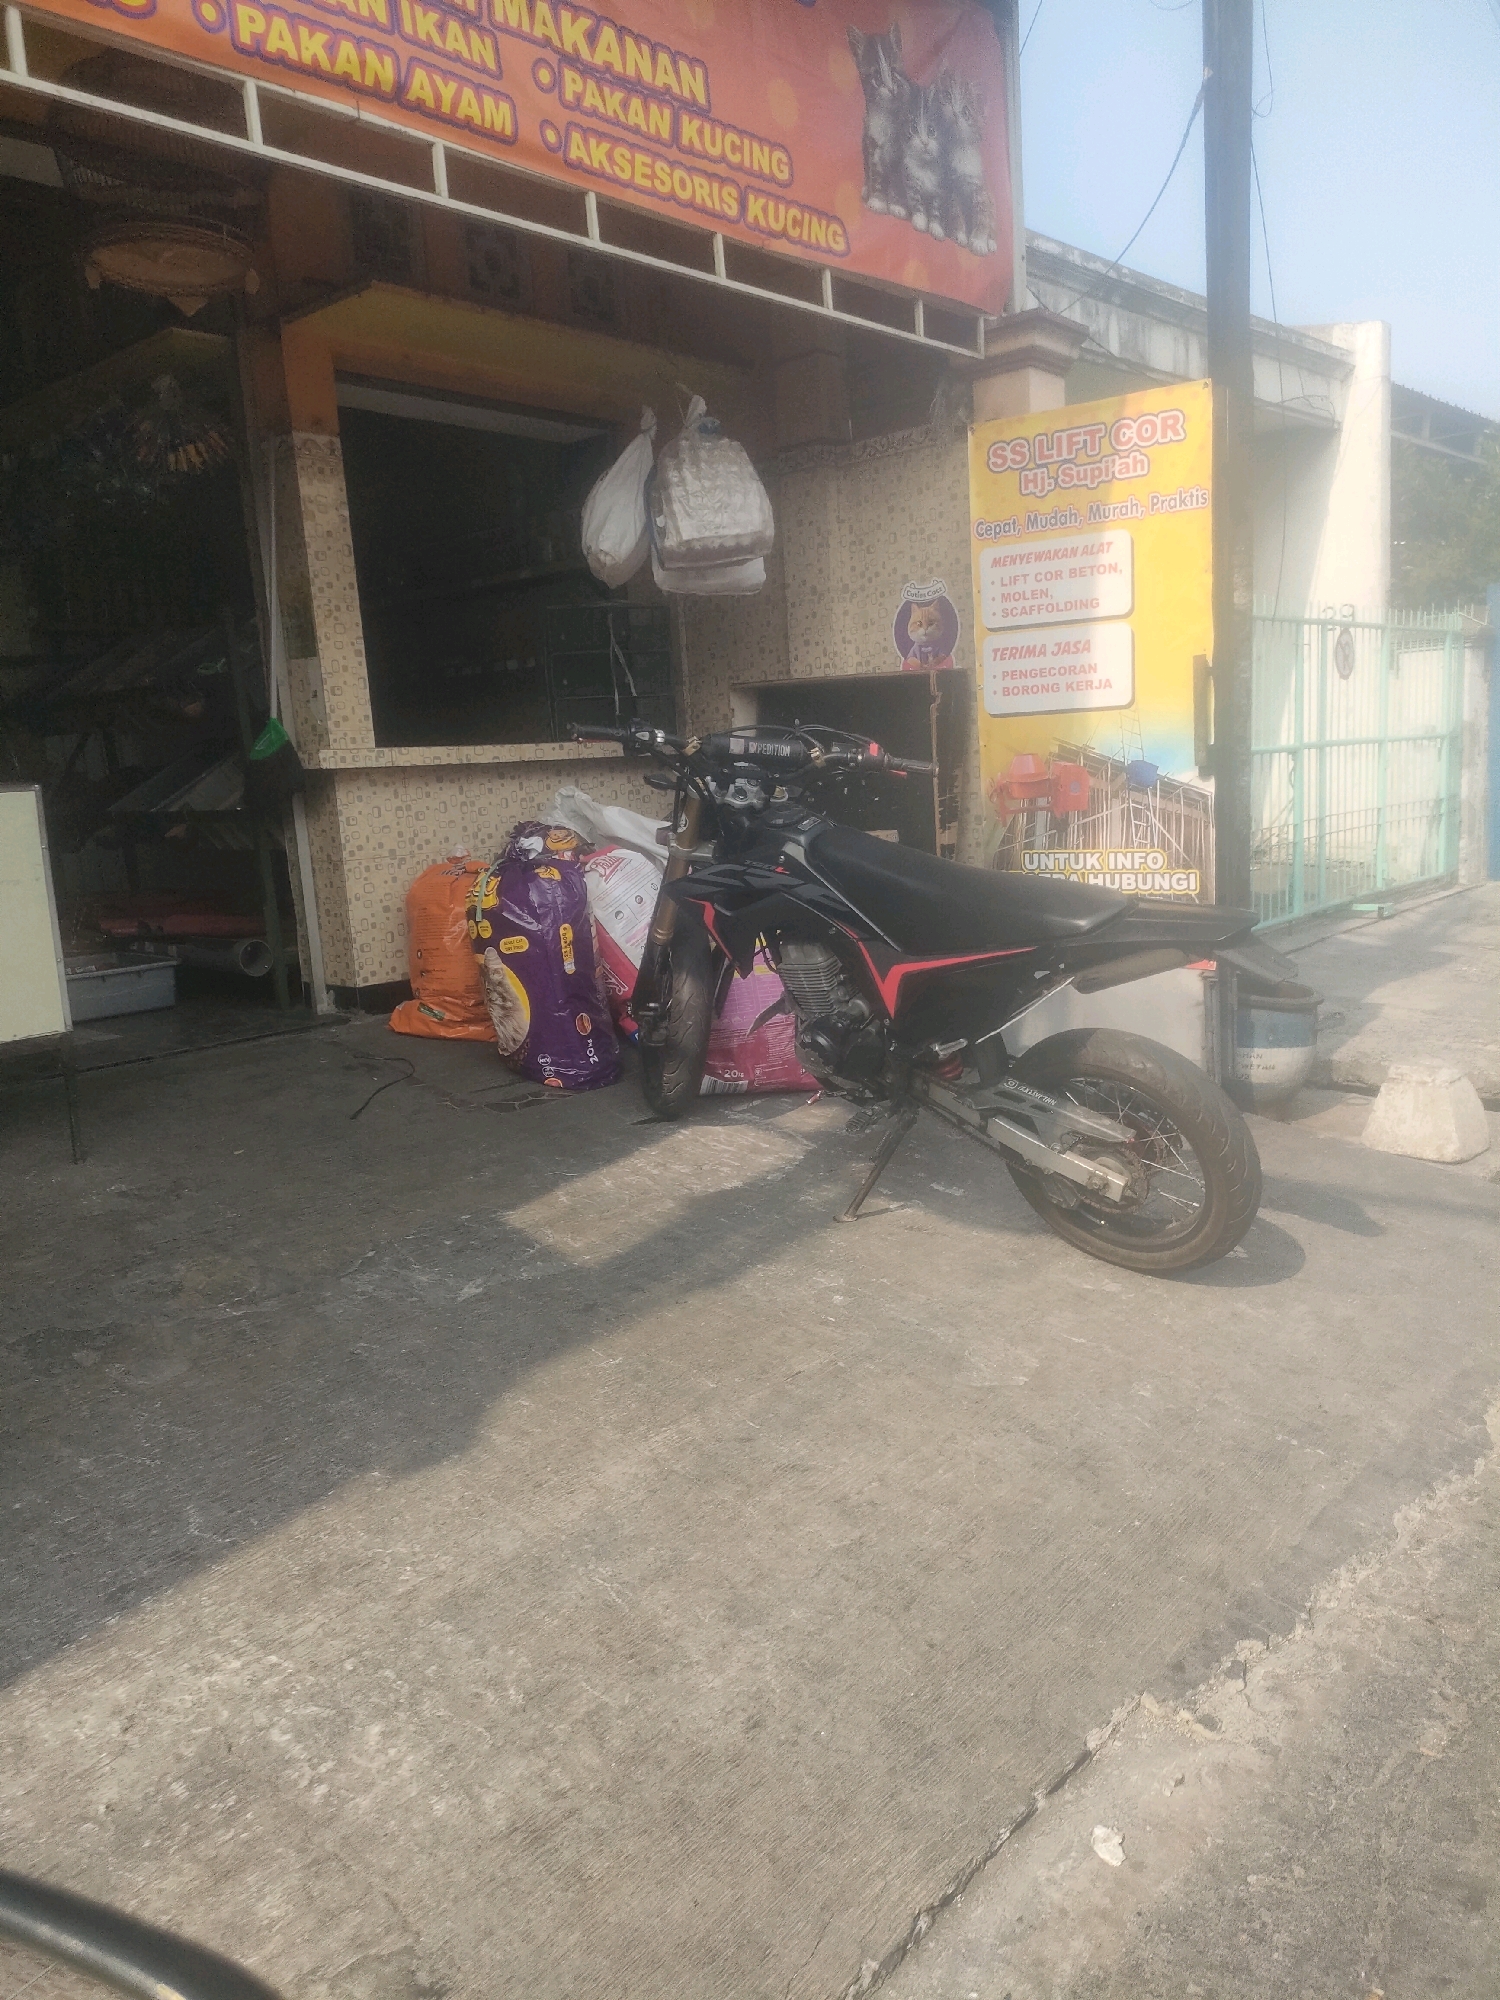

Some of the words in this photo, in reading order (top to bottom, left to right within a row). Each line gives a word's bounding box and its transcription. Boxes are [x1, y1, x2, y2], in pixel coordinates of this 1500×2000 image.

[401, 1, 496, 70] IKAN
[494, 0, 707, 105] MAKANAN
[236, 3, 394, 93] PAKAN
[407, 67, 512, 137] AYAM
[562, 67, 672, 145] PAKAN
[680, 116, 790, 182] KUCING
[568, 131, 740, 218] AKSESORIS
[746, 193, 846, 252] KUCING
[990, 440, 1028, 471] SS
[1037, 427, 1104, 463] LIFT
[1112, 413, 1184, 449] COR
[1022, 470, 1053, 495] Hj.
[1059, 454, 1148, 487] Supi'ah
[975, 520, 1021, 540] Cepat,
[1027, 508, 1083, 530] Mudah,
[1088, 496, 1145, 521] Murah,
[1150, 488, 1208, 513] Praktis
[991, 545, 1078, 568] MENYEWAKAN
[1081, 541, 1113, 557] ALAT
[1000, 573, 1030, 588] LIFT
[1034, 568, 1063, 583] COR
[1068, 562, 1123, 579] BETON,
[1000, 588, 1053, 604] MOLEN,
[1001, 598, 1100, 618] SCAFFOLDING
[992, 644, 1047, 661] TERIMA
[1051, 639, 1091, 656] JASA
[1001, 663, 1097, 681] PENGECORAN
[1002, 682, 1060, 697] BORONG
[1065, 678, 1112, 693] KERJA
[1024, 852, 1102, 870] UNTUK
[1108, 852, 1164, 870] INFO
[1088, 873, 1196, 890] HUBUNGI
